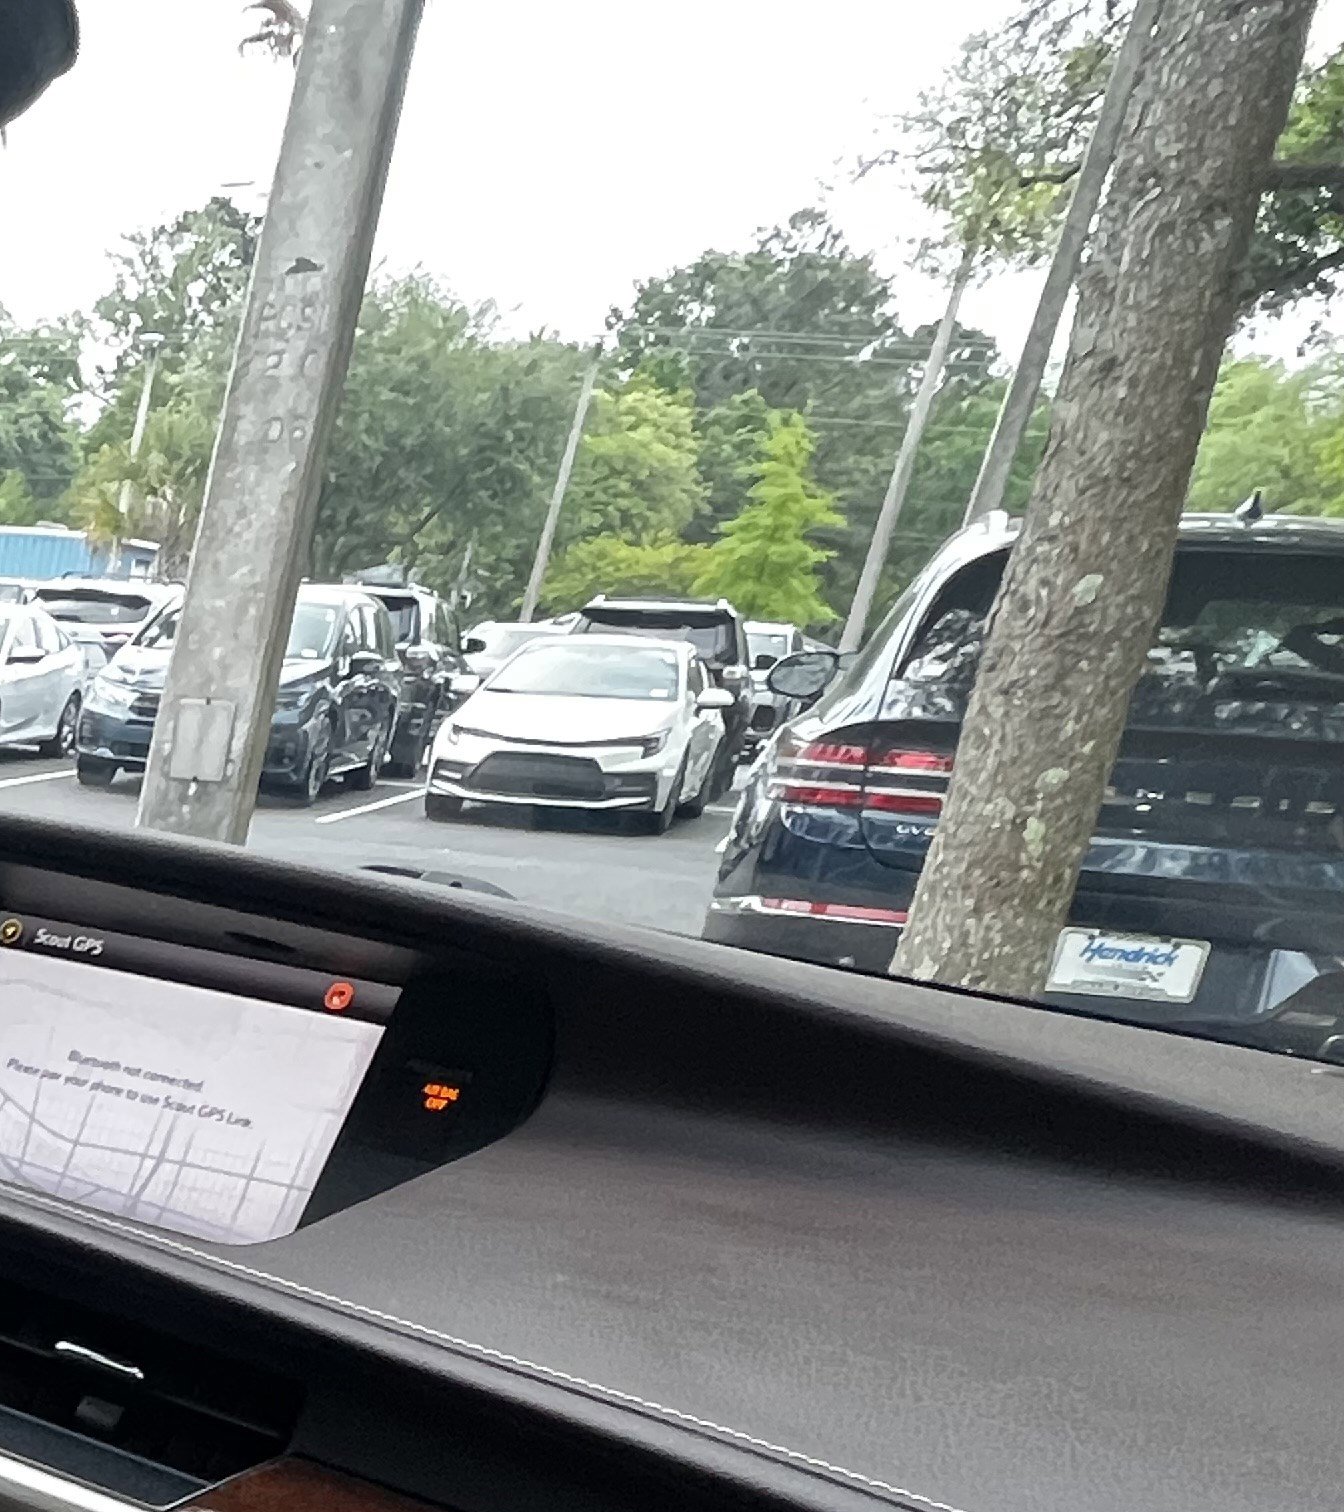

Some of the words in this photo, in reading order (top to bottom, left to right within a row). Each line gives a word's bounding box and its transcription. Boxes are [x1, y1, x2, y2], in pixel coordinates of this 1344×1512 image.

[33, 927, 71, 951] Scout
[71, 934, 104, 956] GPS
[1078, 938, 1179, 968] Hendrick
[161, 1094, 196, 1114] Scout
[198, 1104, 226, 1122] GPS
